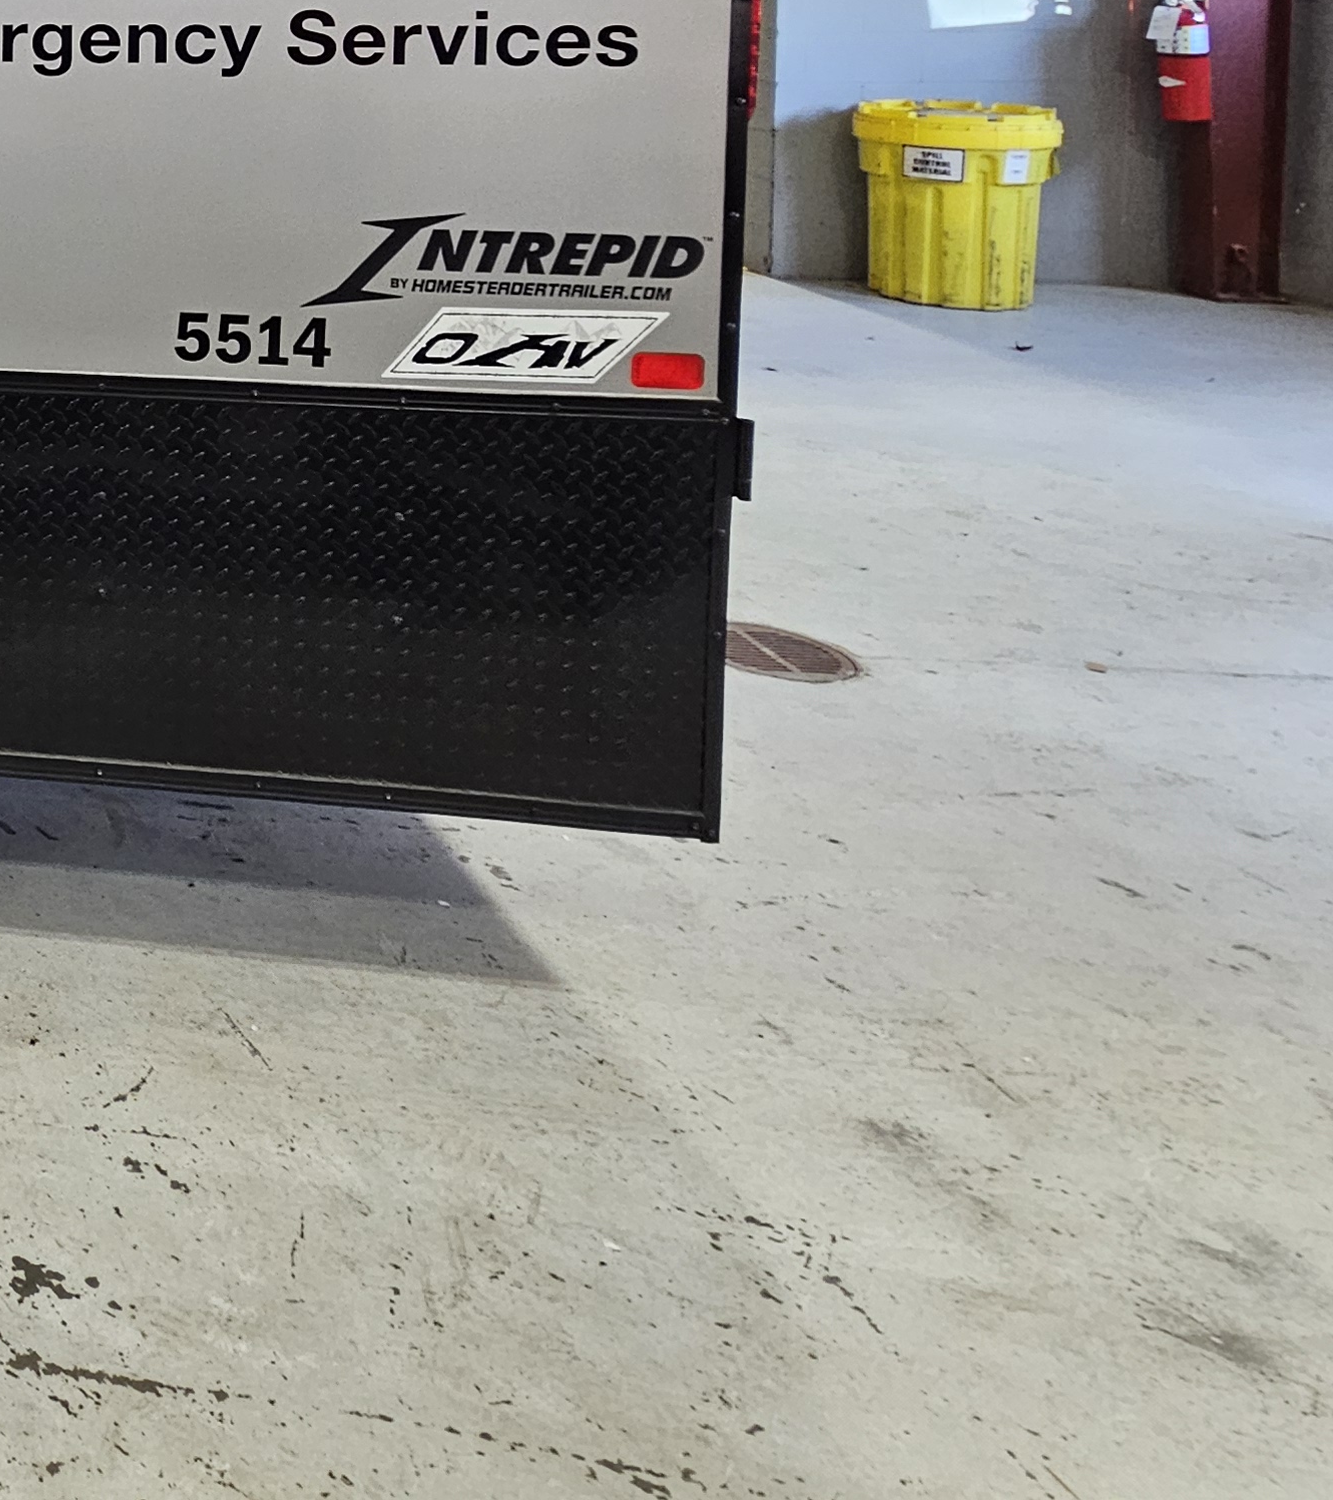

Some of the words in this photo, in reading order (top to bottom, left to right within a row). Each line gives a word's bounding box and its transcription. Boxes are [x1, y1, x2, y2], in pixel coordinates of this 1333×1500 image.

[286, 7, 640, 68] Services
[299, 212, 706, 308] INTREPID
[389, 278, 408, 289] BY
[411, 278, 673, 301] HOMESTEADERTRAILER.COM
[173, 311, 332, 368] 5514
